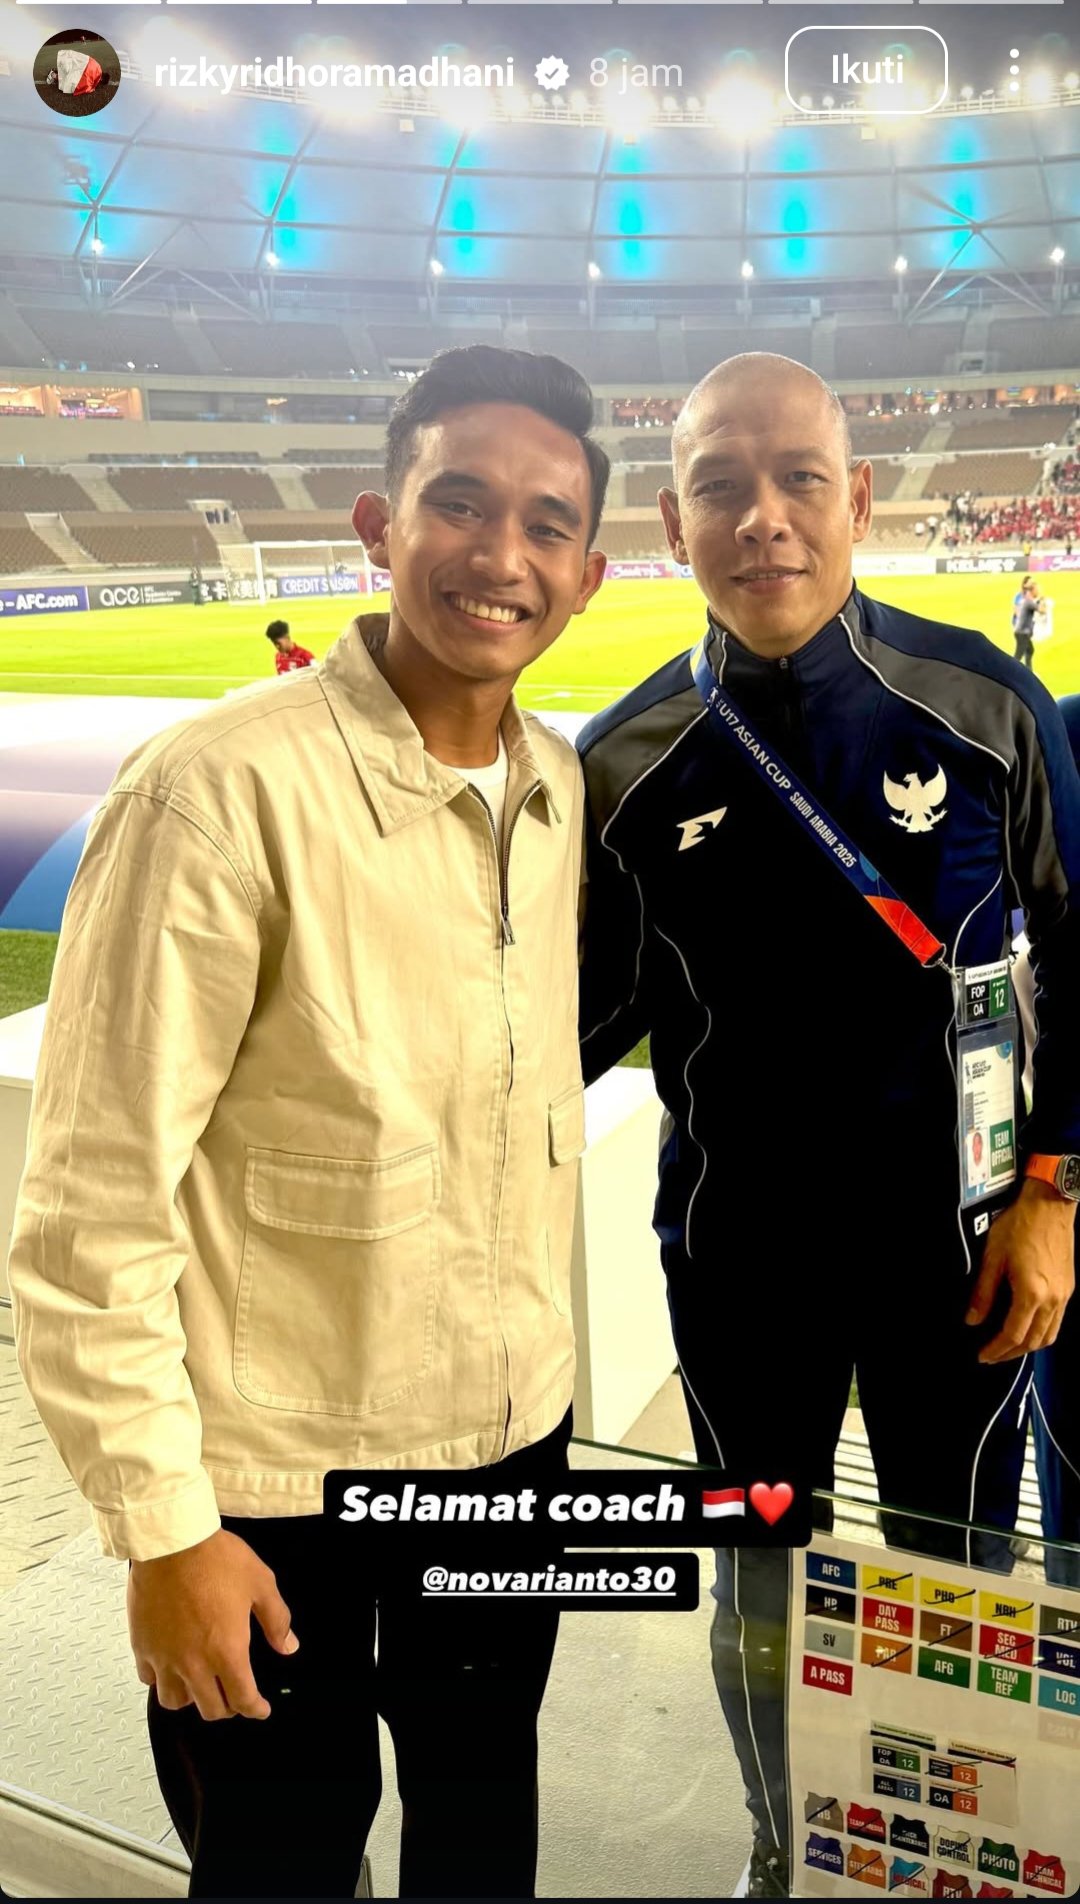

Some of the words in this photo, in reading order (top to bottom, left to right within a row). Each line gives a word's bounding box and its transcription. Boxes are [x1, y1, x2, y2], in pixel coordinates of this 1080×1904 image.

[282, 578, 320, 594] CREDIT
[100, 586, 140, 607] ace
[719, 703, 739, 726] U17
[733, 725, 770, 765] ASIAN
[765, 762, 791, 789] CUP
[789, 791, 815, 819] SAUDI
[808, 815, 838, 847] ARABIA
[833, 843, 857, 868] 2025
[971, 985, 986, 999] FOP
[995, 988, 1005, 1009] 12
[973, 1003, 984, 1016] OA
[822, 1563, 840, 1577] AFC
[879, 1604, 897, 1618] DAY
[875, 1616, 899, 1632] PASS
[940, 1623, 952, 1636] FT
[823, 1633, 836, 1647] SV
[997, 1632, 1016, 1647] SEC
[934, 1660, 954, 1675] AFG
[810, 1666, 817, 1679] A
[820, 1668, 845, 1686] PASS
[991, 1667, 1018, 1685] TEAM
[995, 1681, 1014, 1697] REF
[1056, 1688, 1076, 1706] LOC
[902, 1759, 914, 1769] 12
[960, 1771, 972, 1781] 12
[904, 1788, 915, 1798] 12
[934, 1793, 949, 1804] OA
[960, 1800, 972, 1810] 12
[982, 1852, 1016, 1871] PHOTO
